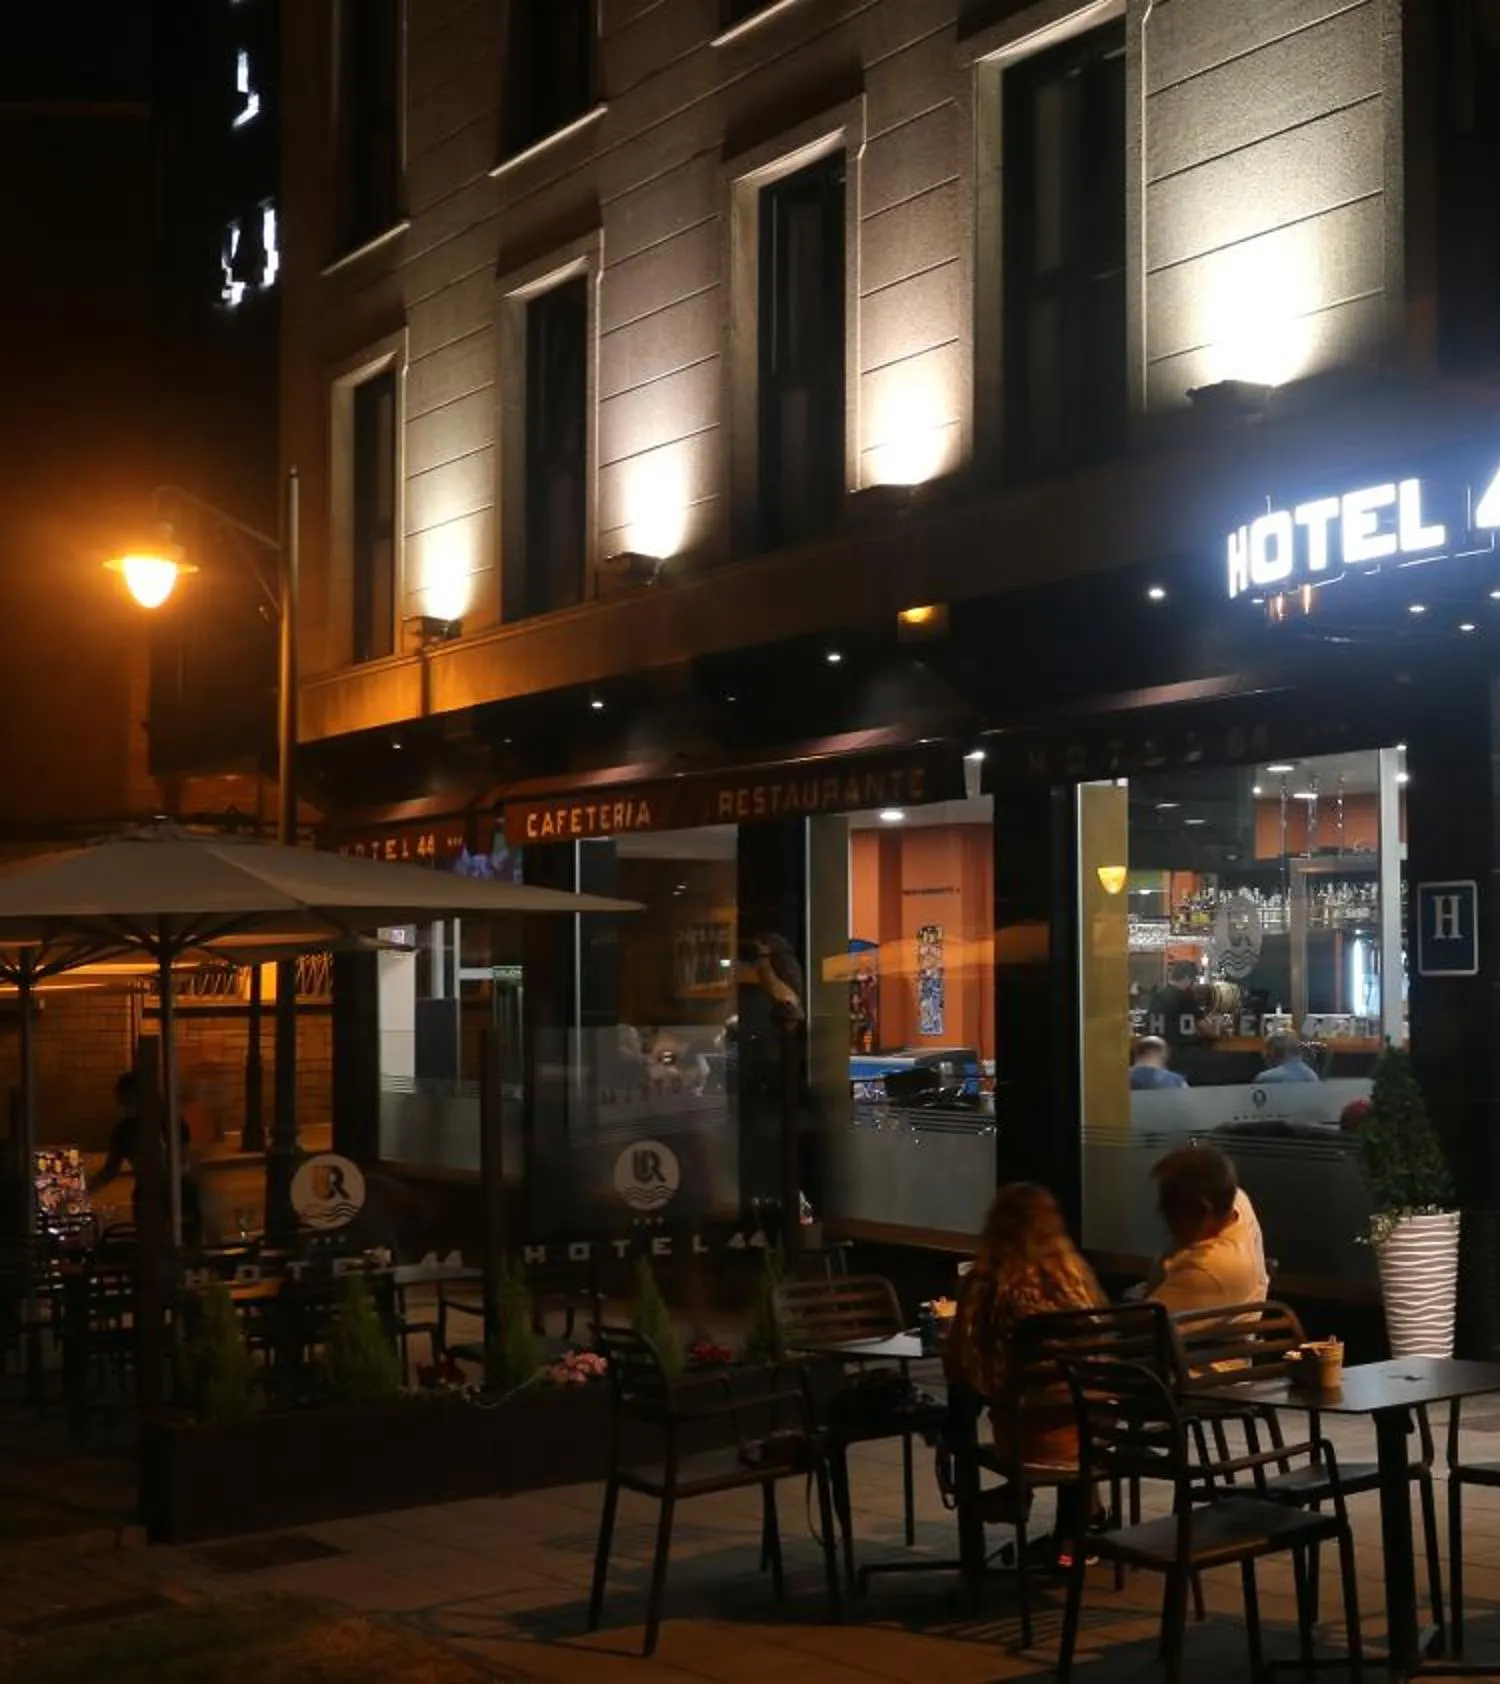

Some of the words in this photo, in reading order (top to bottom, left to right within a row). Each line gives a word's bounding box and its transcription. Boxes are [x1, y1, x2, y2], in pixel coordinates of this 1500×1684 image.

[1227, 478, 1446, 599] HOTEL
[718, 767, 925, 821] RESTAURANTE
[526, 799, 652, 838] CAFETERIA
[1433, 894, 1462, 940] H
[524, 1232, 711, 1265] HOTEL
